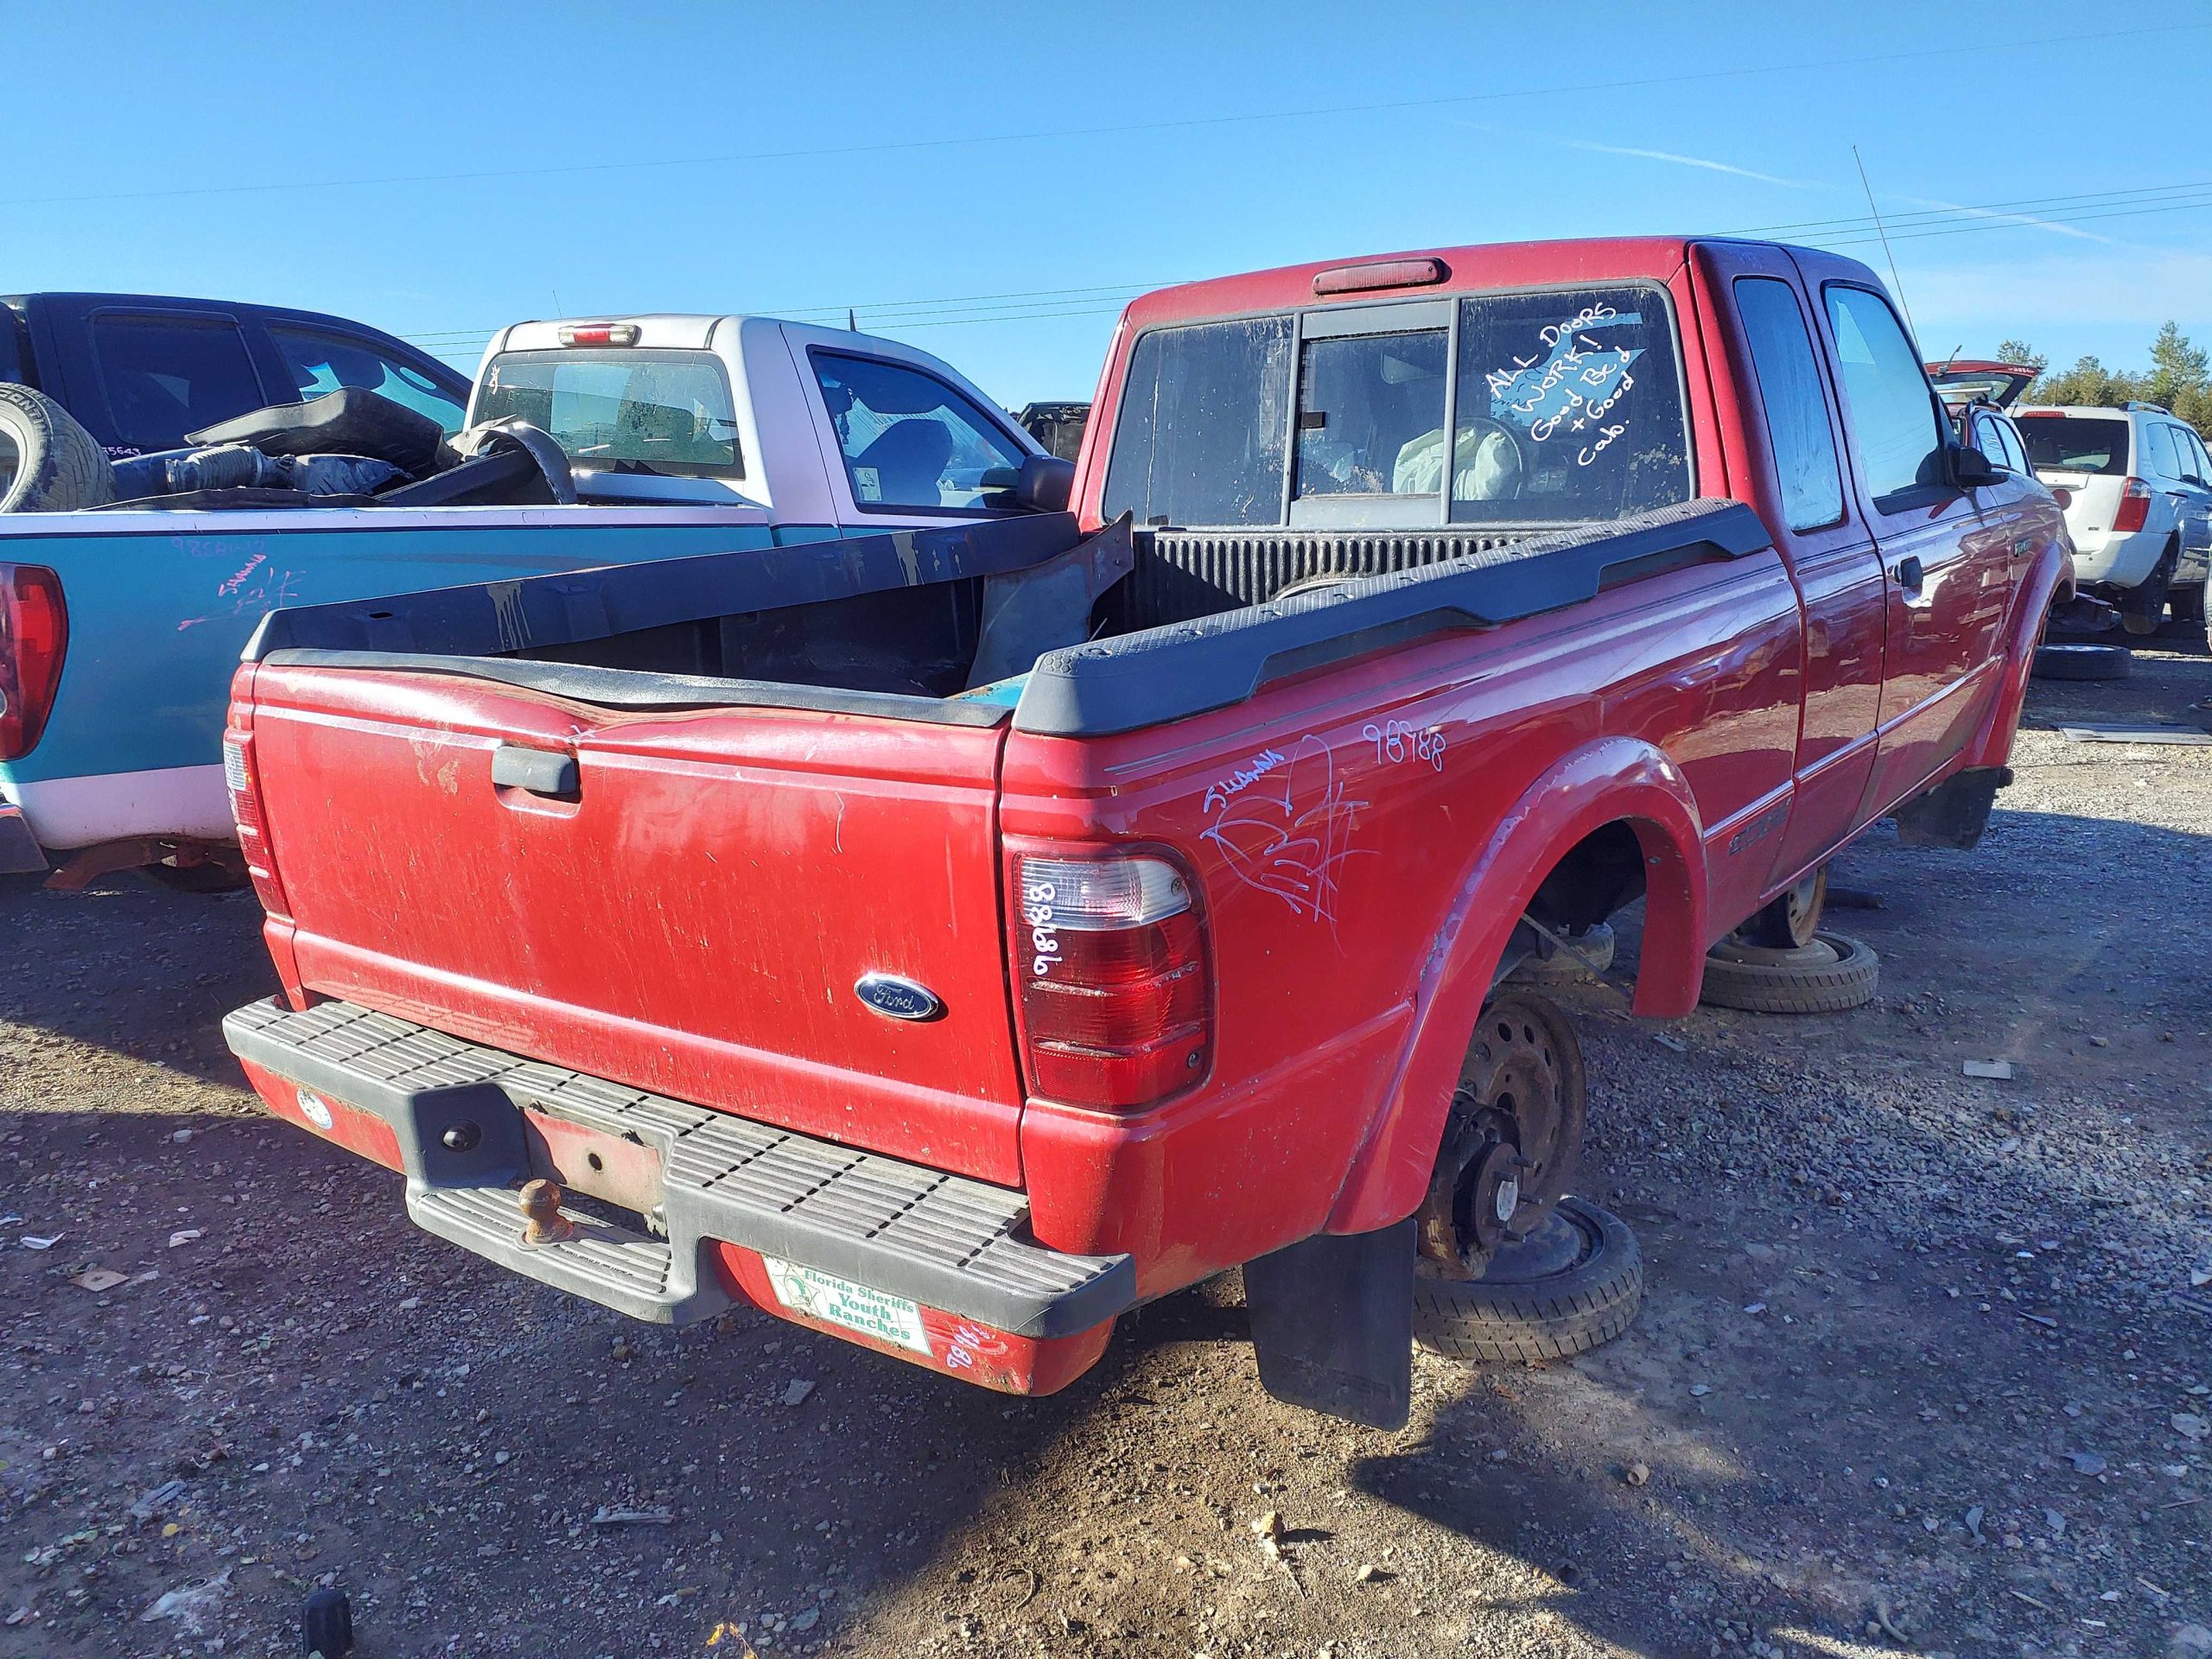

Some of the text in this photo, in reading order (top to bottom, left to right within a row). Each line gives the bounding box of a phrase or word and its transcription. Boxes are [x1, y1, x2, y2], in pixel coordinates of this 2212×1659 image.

[1485, 353, 1539, 399] ALL
[1586, 370, 1635, 420] Good
[1531, 389, 1583, 442] Good
[873, 984, 915, 1010] Ford
[804, 1269, 914, 1313] Florida Sheriffs
[838, 1293, 892, 1321] Youth
[830, 1303, 911, 1340] Ranches
